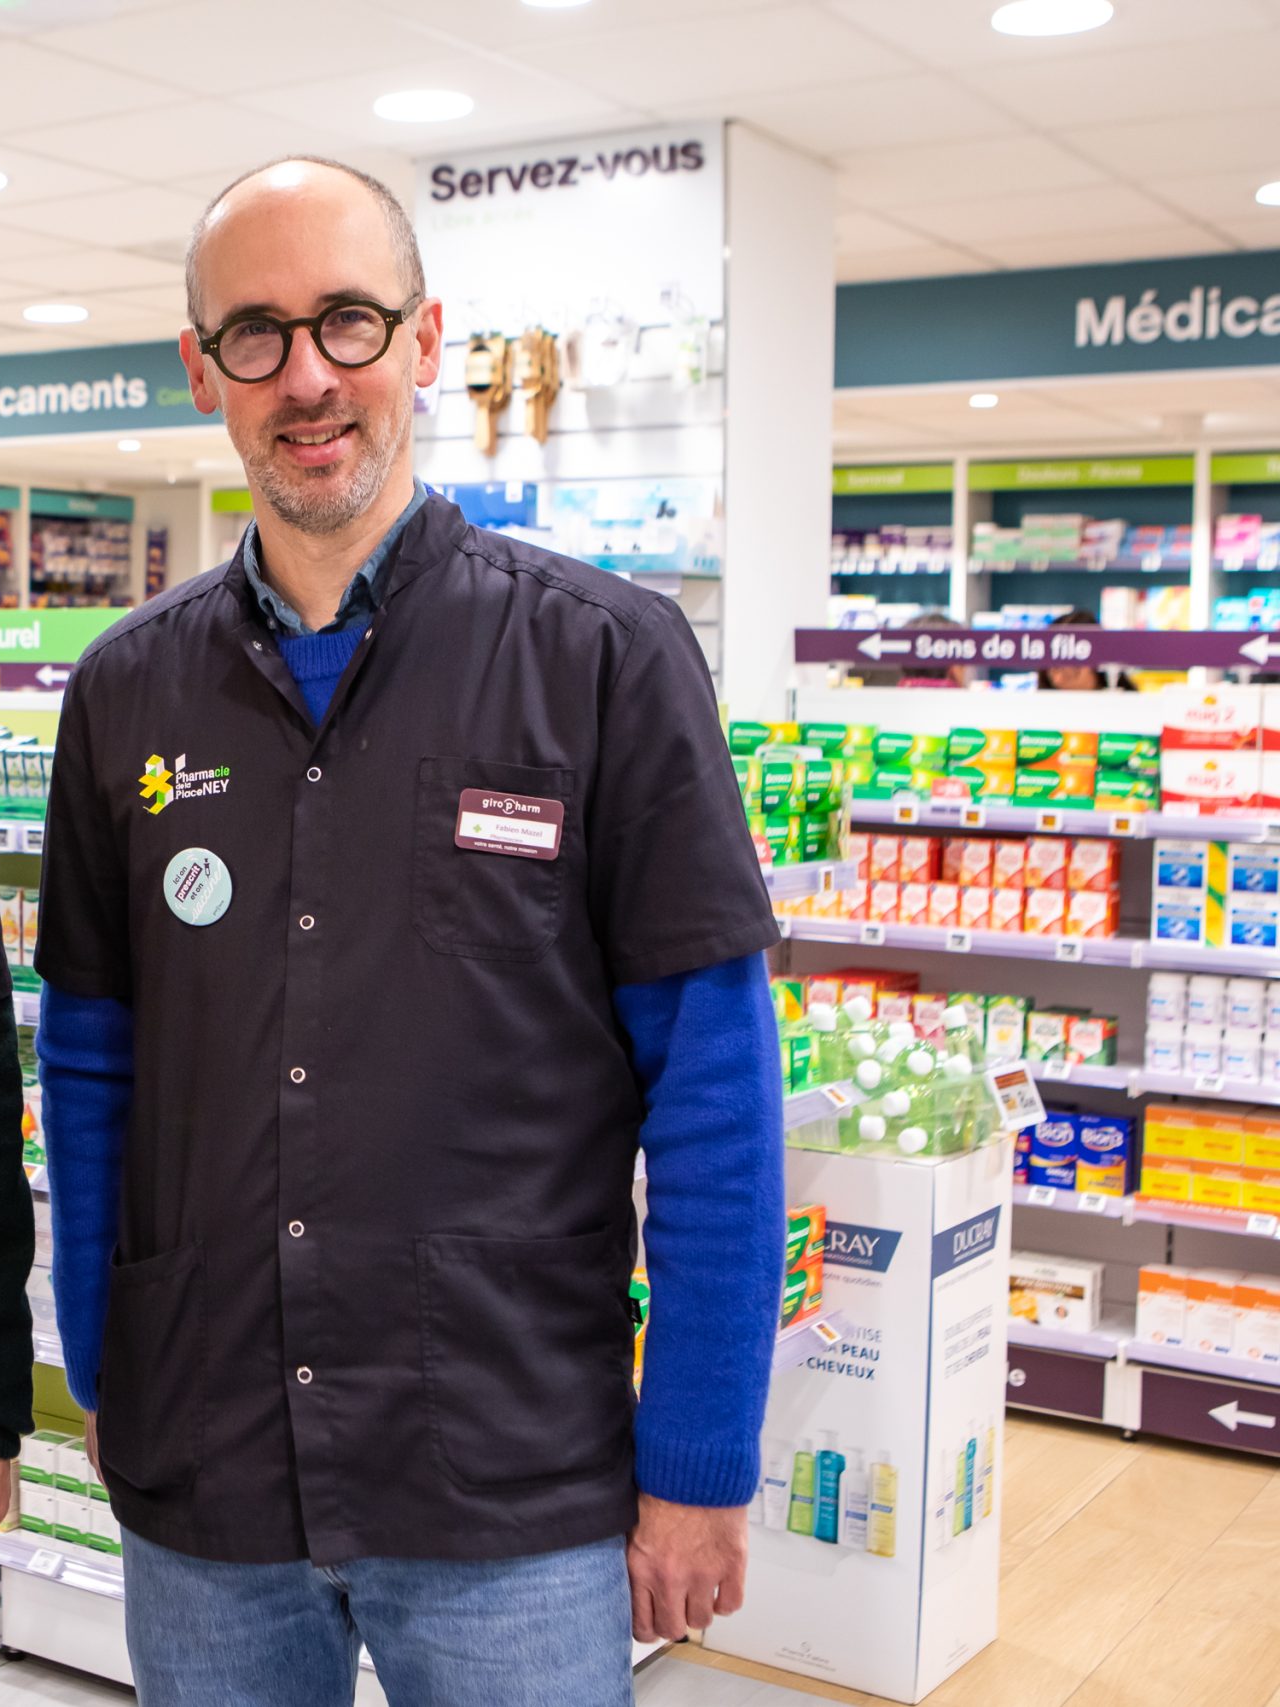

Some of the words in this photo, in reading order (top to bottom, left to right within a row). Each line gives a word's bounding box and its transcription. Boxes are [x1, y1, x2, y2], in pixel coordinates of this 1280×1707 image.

[431, 141, 704, 202] Servez-vous
[1075, 286, 1280, 347] Médica
[915, 634, 976, 659] Sens
[982, 634, 1015, 659] de
[1021, 634, 1045, 659] la
[1050, 634, 1092, 660] file
[175, 765, 230, 784] Pharmacie
[177, 865, 201, 901] prescrit
[842, 1343, 880, 1362] PEAU
[806, 1356, 876, 1381] CHEVEUX
